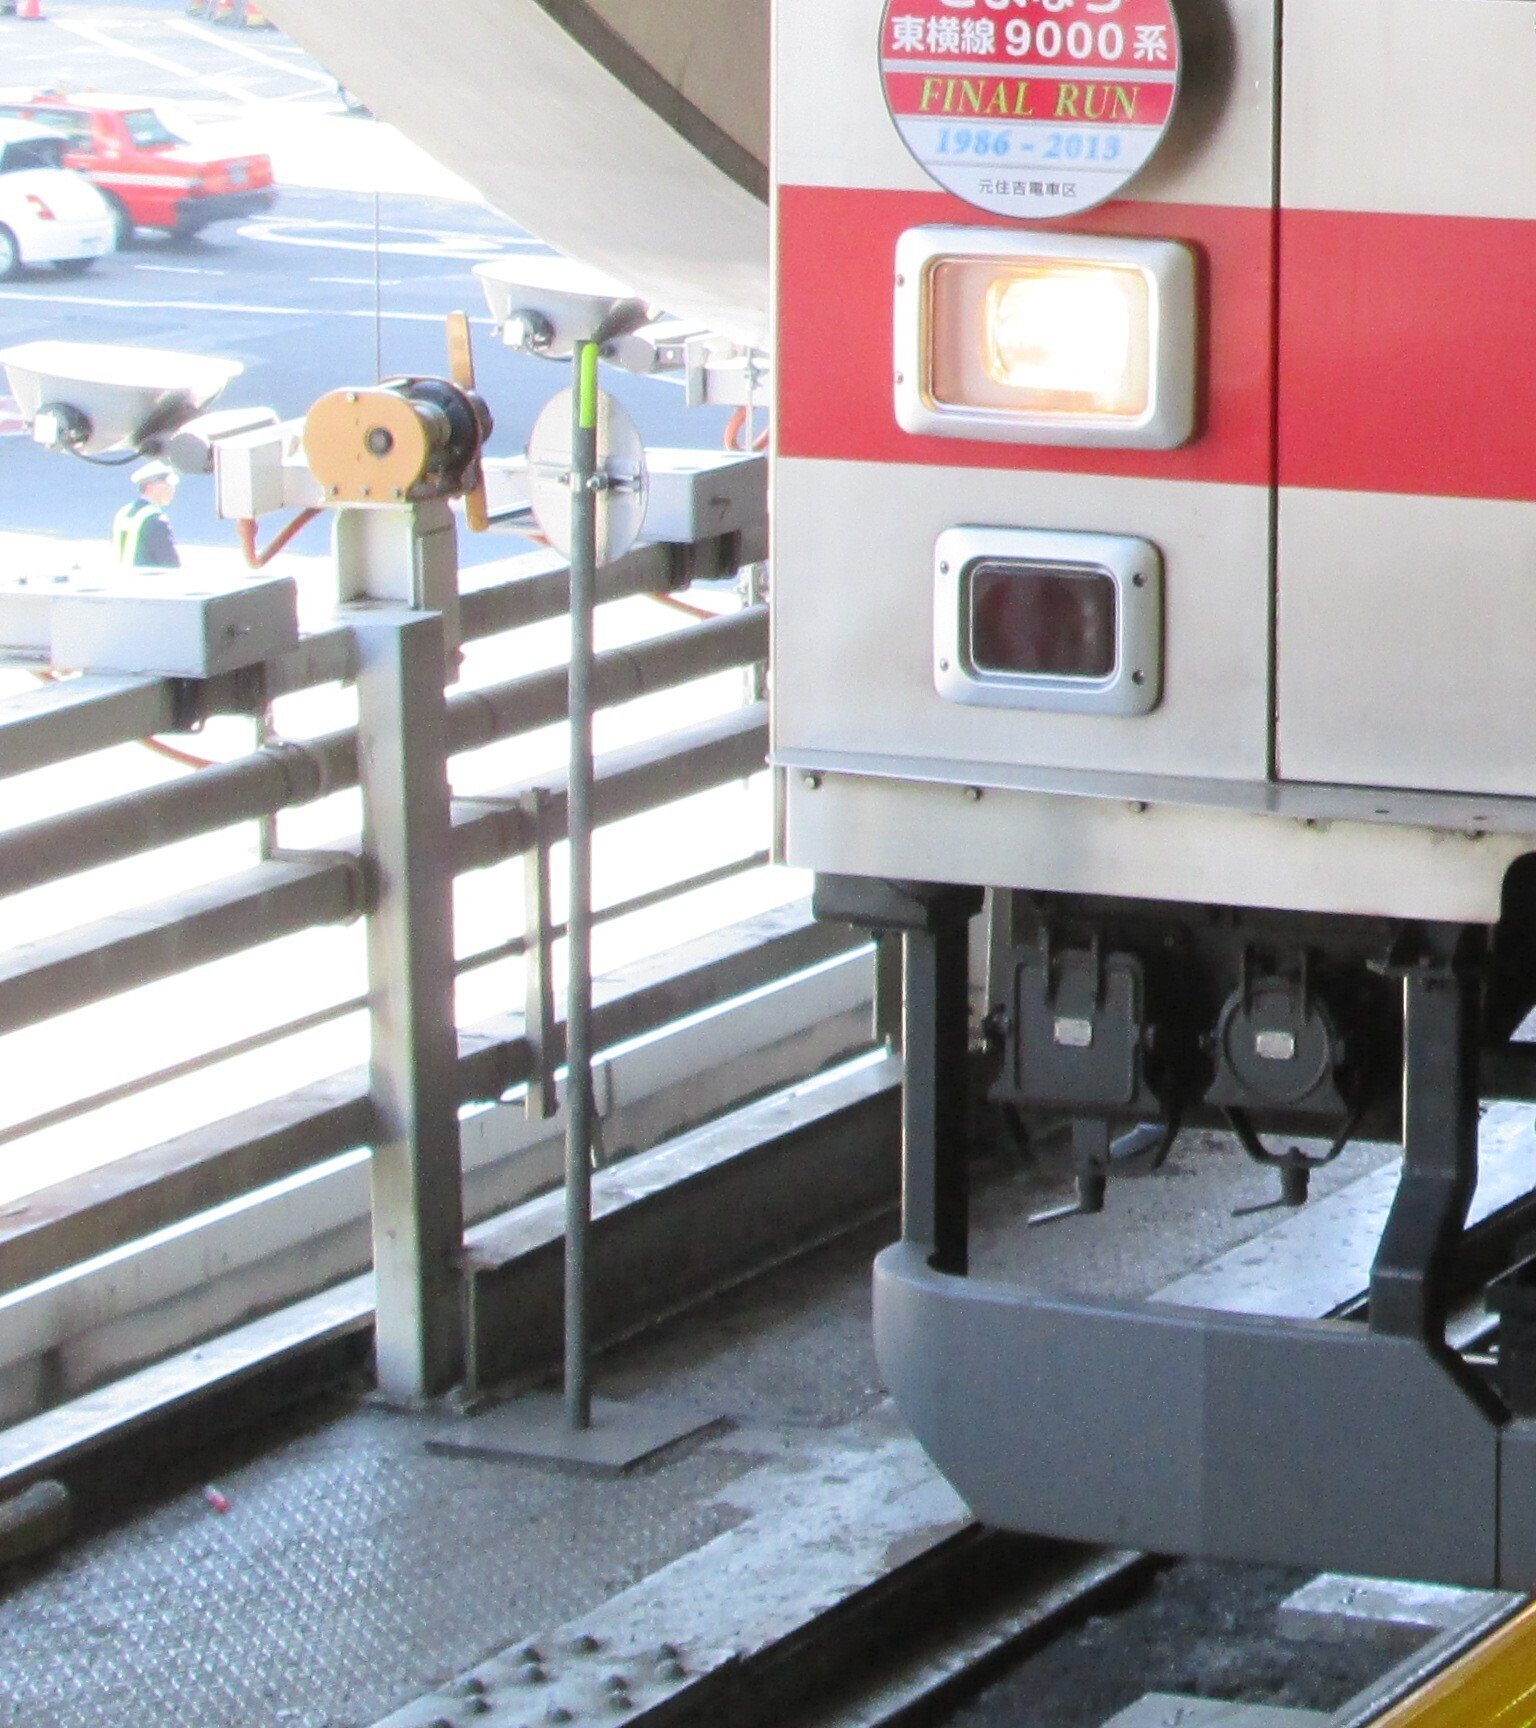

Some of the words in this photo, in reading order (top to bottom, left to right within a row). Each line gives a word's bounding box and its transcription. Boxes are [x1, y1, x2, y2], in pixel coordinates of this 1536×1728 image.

[918, 76, 1034, 117] FINAL
[1053, 82, 1142, 120] RUN
[935, 127, 1012, 156] 1986
[1042, 132, 1122, 161] 2013
